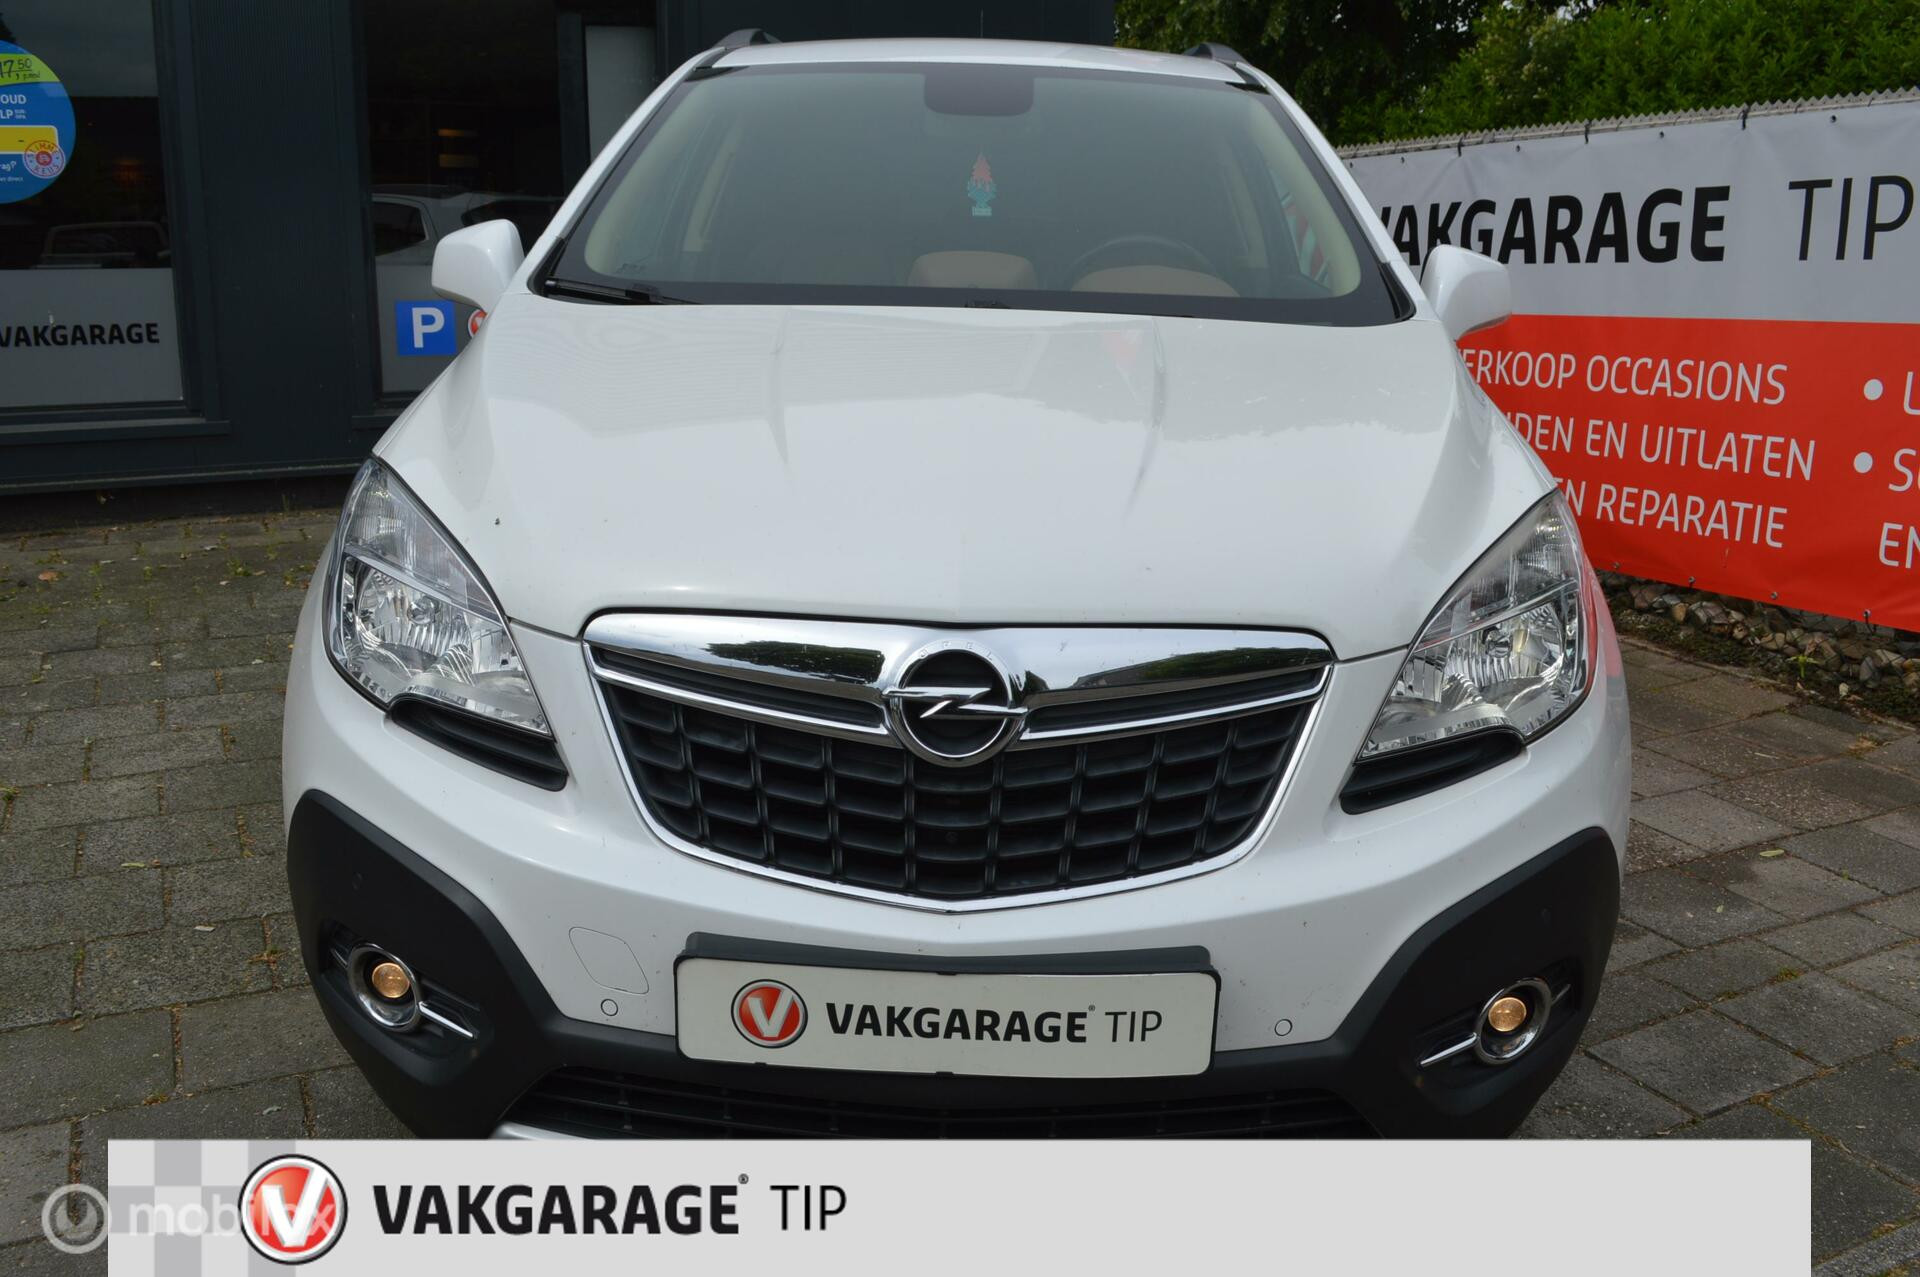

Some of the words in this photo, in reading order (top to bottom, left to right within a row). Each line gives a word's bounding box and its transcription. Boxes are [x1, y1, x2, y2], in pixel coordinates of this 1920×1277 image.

[1381, 185, 1730, 265] AKGARAGE
[1789, 175, 1914, 261] TIP
[0, 323, 160, 347] VAKGARAGE
[411, 306, 445, 348] P
[1459, 349, 1576, 389] ERKOOP
[1587, 354, 1788, 405] OCCASIONS
[1506, 411, 1575, 454] DEN
[1585, 419, 1628, 459] EN
[1640, 424, 1816, 481] UITLATEN
[1596, 483, 1788, 548] REPARATIE
[1105, 1010, 1163, 1042] TIP
